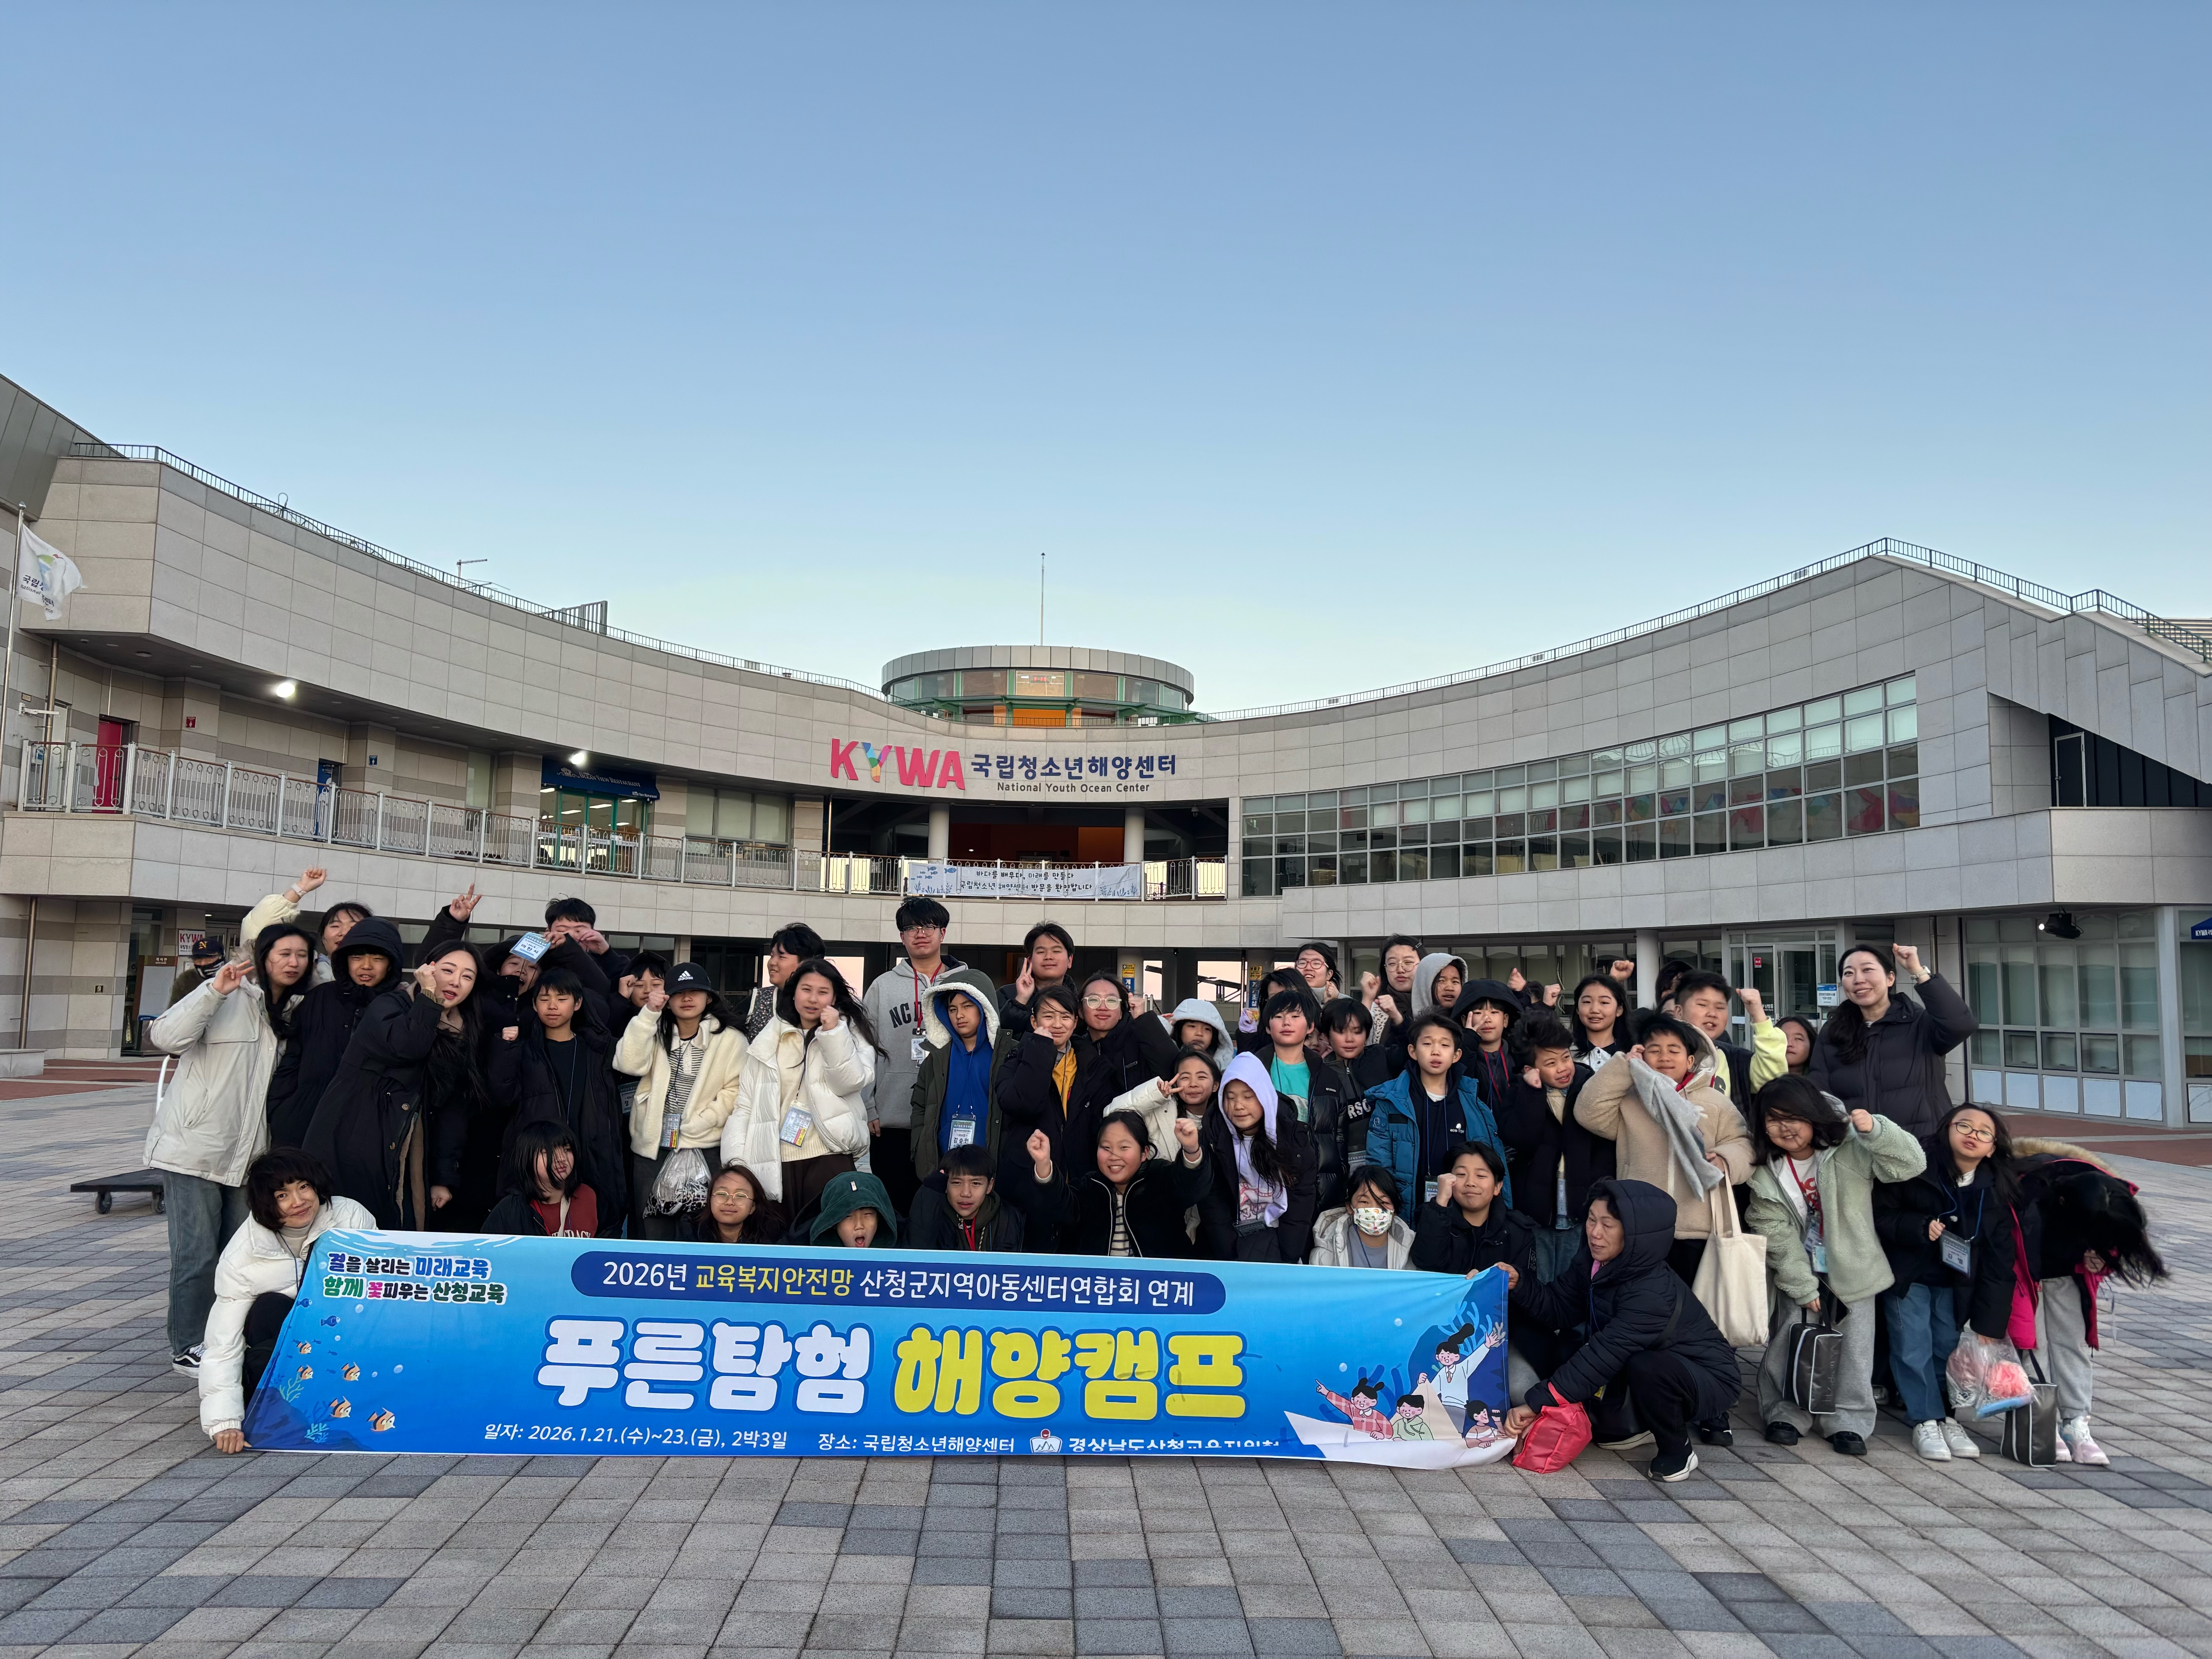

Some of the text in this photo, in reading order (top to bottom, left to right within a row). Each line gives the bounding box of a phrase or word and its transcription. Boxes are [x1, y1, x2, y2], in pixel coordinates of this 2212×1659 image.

[830, 738, 965, 790] KYWA
[971, 754, 1176, 780] 국립청소년해양센터
[997, 782, 1149, 793] National Youth Ocean Center
[960, 881, 1092, 892] 국립청소년 해양센터 방문을 환영합니다
[976, 870, 998, 879] 바다를
[1028, 872, 1049, 881] 미래를
[1052, 872, 1074, 881] 만들다
[329, 1253, 489, 1278] 결을 살리는 미래교육
[325, 1276, 505, 1304] 함께 꽃피우는 산청교육
[603, 1261, 1194, 1307] 2026년 교육복지안전망 산청군지역아동센터연합회 연계
[537, 1319, 1246, 1421] 푸른탐험 해양캠프
[484, 1423, 787, 1449] 일자: 2026.1.21.(수)~23.(금), 2박3일
[818, 1433, 1014, 1453] 장소: 국립청소년해양센터
